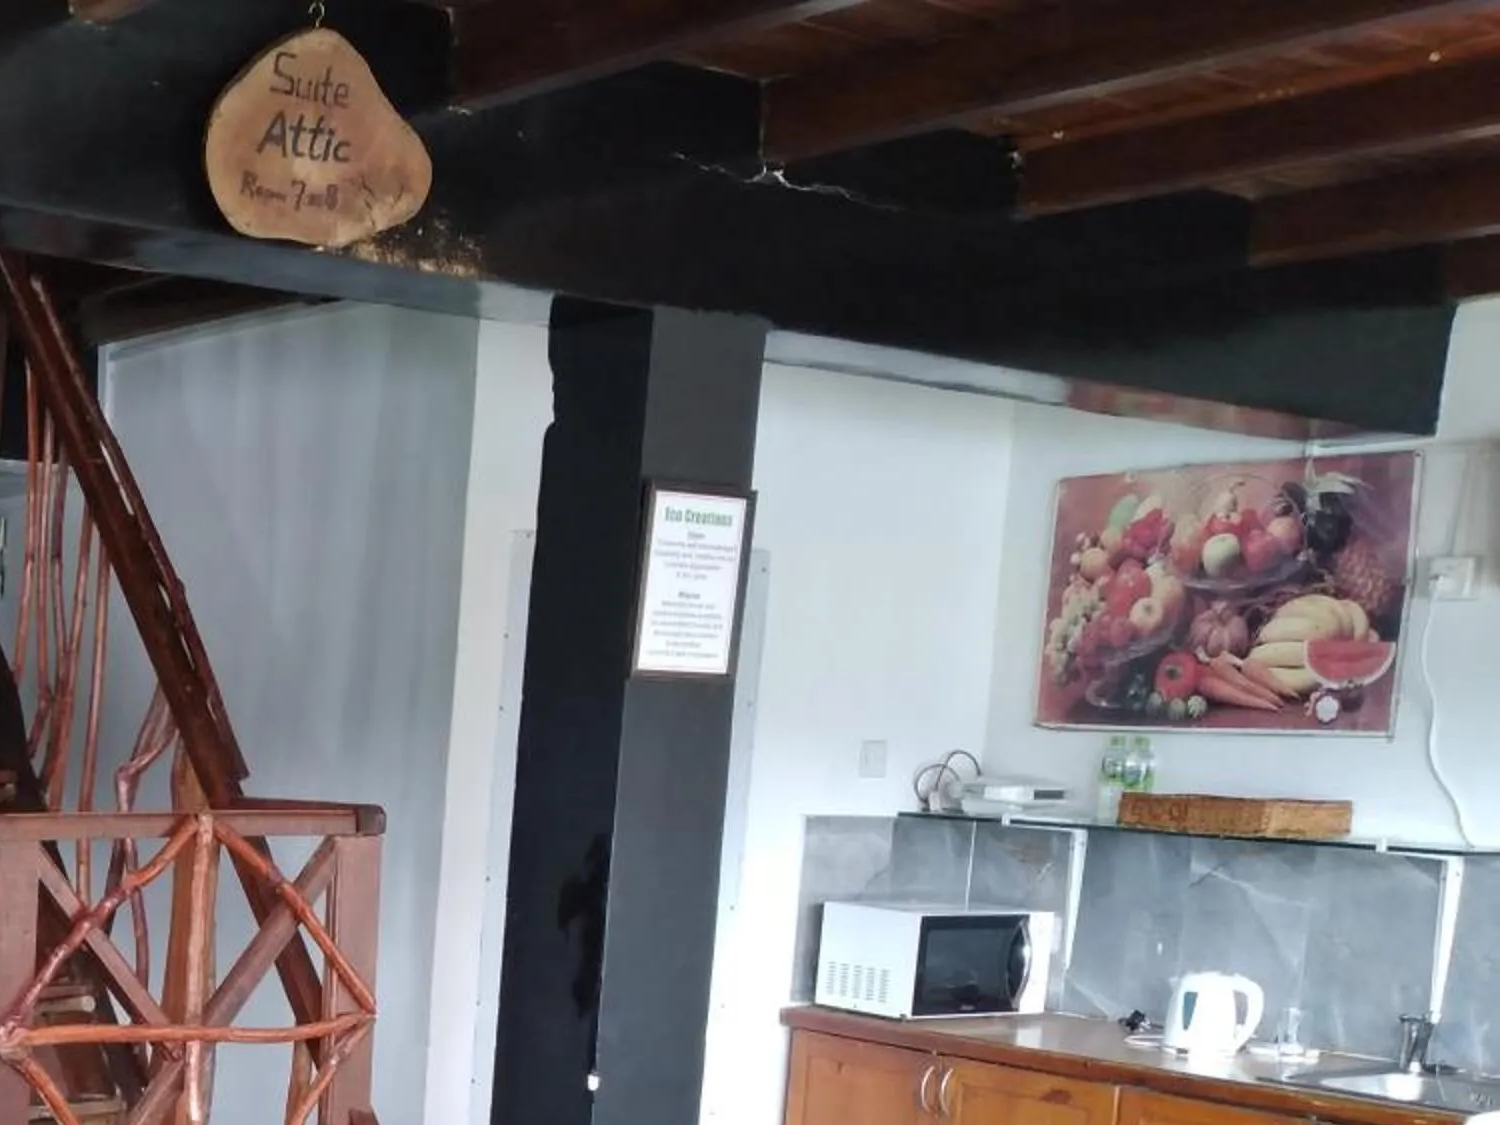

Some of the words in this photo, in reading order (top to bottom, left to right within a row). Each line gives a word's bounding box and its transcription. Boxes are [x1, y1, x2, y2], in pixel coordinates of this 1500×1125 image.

[269, 51, 350, 108] Suite
[256, 109, 351, 163] Attic
[291, 179, 306, 212] 7
